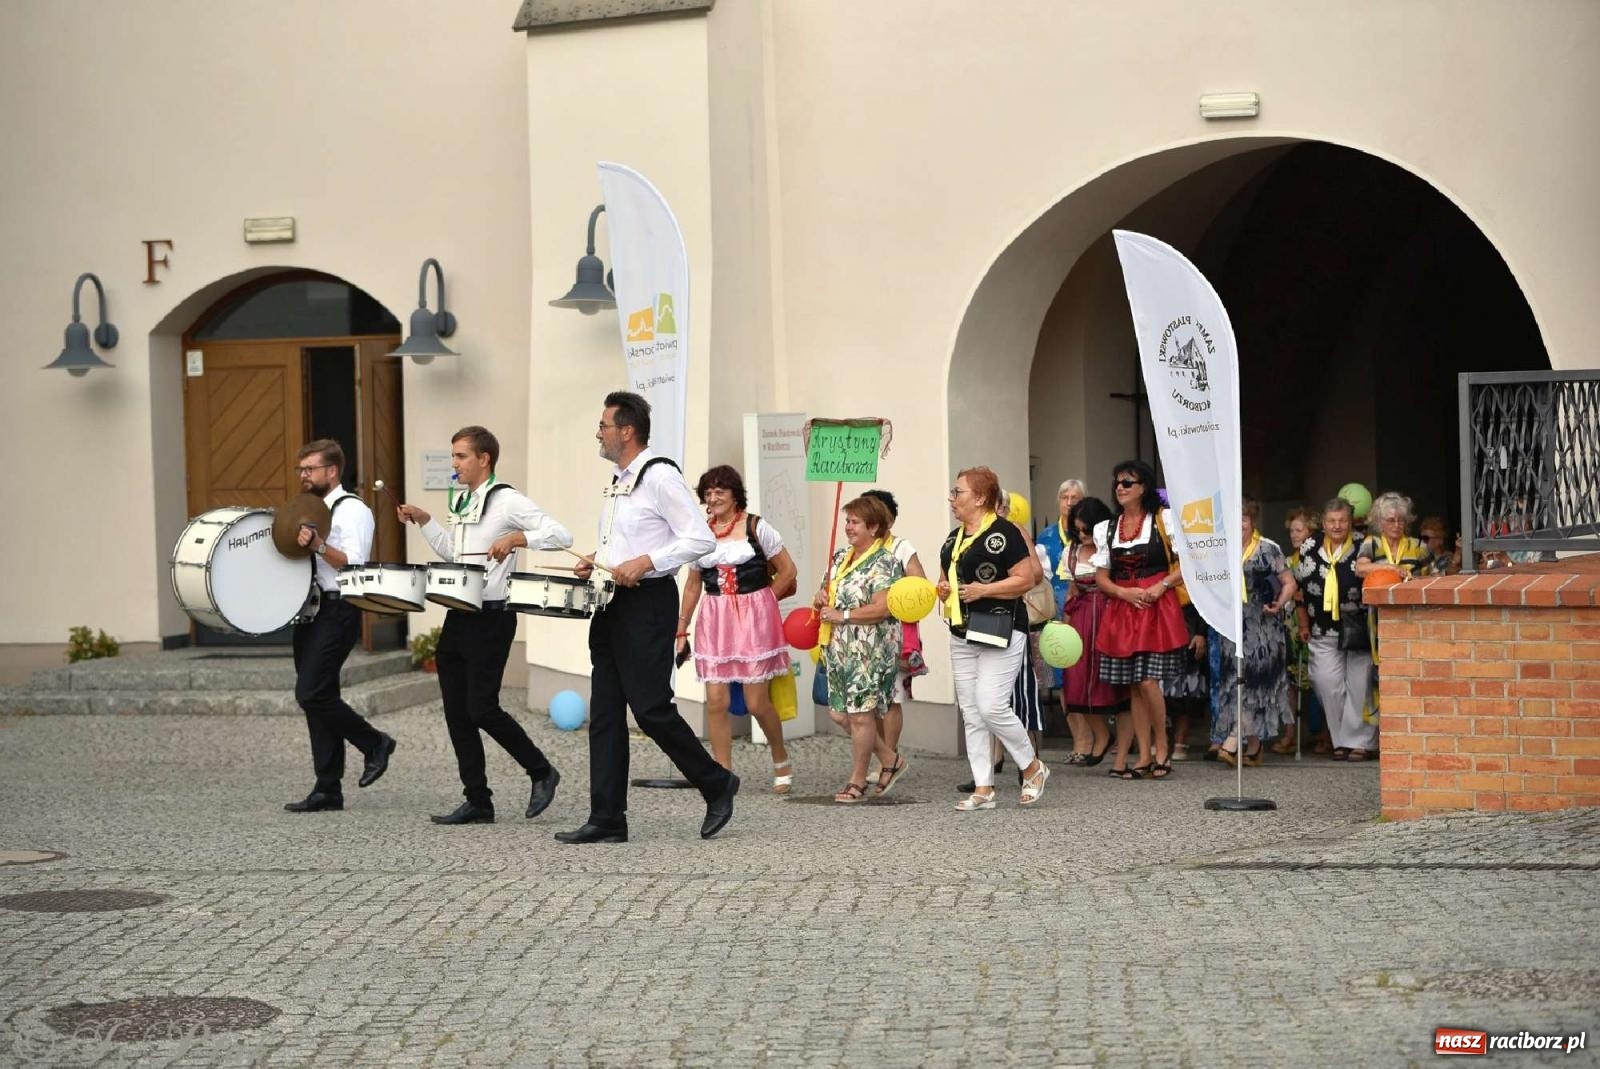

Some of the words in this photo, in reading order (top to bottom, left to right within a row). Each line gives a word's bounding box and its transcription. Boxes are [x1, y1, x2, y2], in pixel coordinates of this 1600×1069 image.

[141, 240, 174, 283] F
[811, 427, 877, 454] Krystyny
[810, 449, 876, 474] Raciborza
